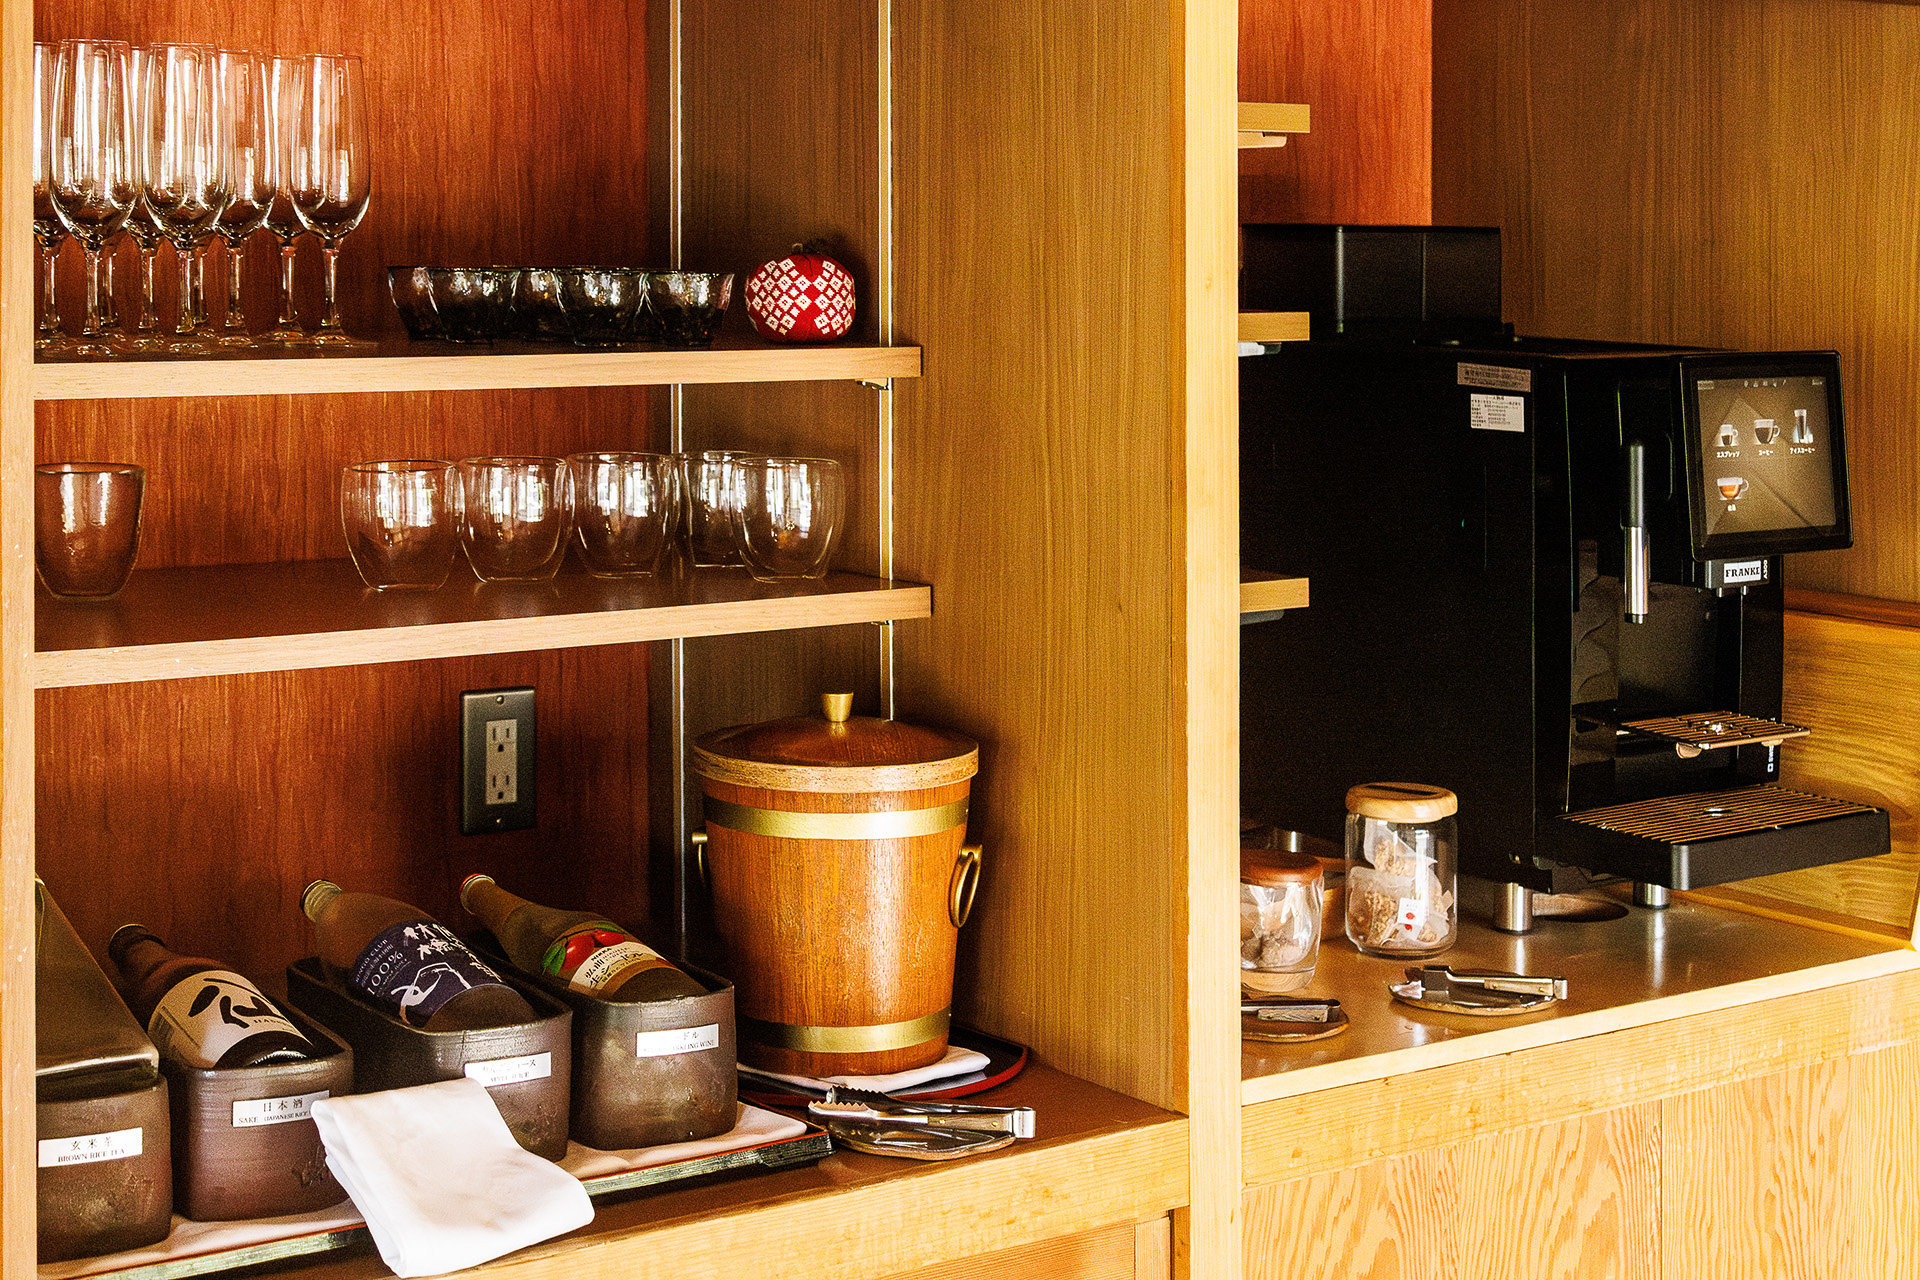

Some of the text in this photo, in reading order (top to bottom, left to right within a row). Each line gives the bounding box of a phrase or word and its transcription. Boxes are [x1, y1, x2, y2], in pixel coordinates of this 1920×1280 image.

[1725, 566, 1760, 577] FRANKE
[367, 951, 403, 995] 100%
[263, 1098, 303, 1112] 日本酒
[238, 1116, 259, 1124] SAKE
[58, 1152, 88, 1163] BROWN
